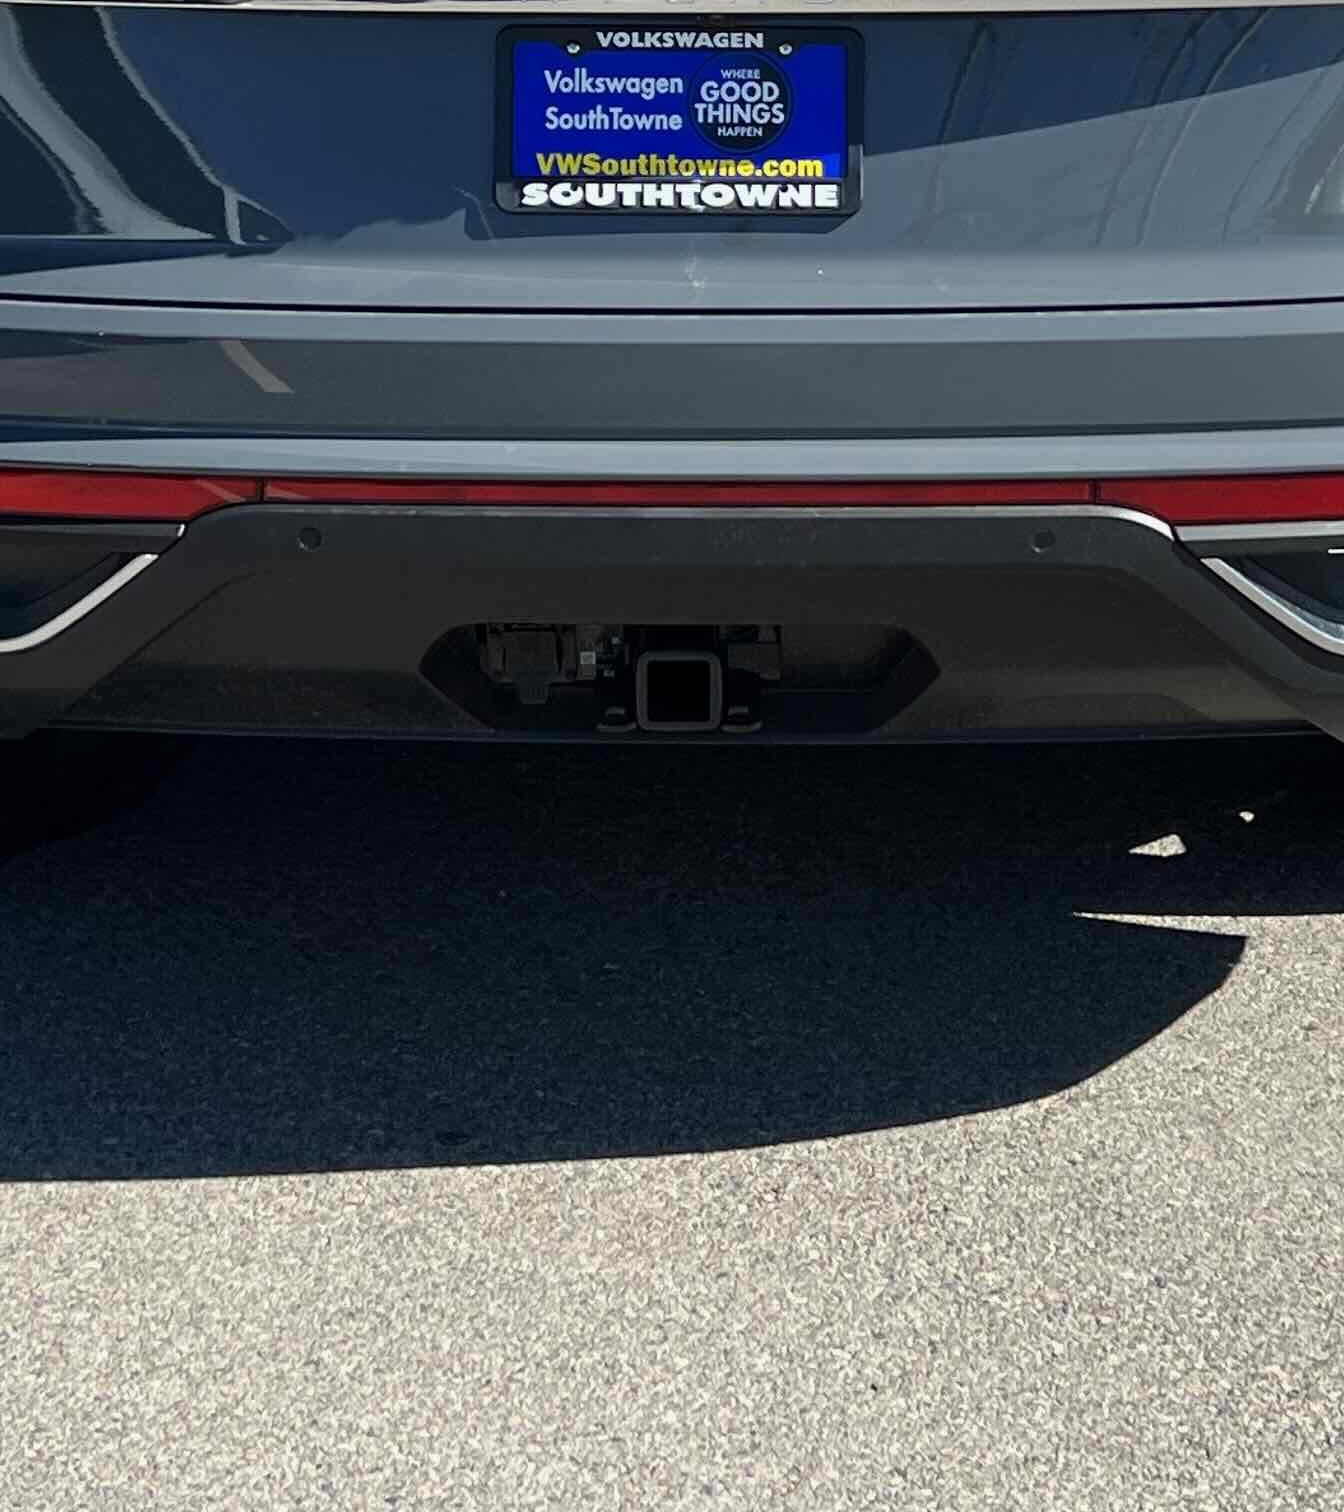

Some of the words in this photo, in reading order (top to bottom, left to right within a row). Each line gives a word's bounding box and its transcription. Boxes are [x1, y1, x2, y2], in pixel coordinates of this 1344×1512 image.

[596, 31, 764, 49] VOLKSWAGEN
[544, 67, 684, 100] Volkswagen
[720, 69, 760, 79] WHERE
[700, 81, 780, 102] GOOD
[695, 103, 785, 125] THINGS
[717, 126, 763, 138] HAPPEN
[536, 152, 823, 178] VWSouthtowne.com
[520, 182, 839, 209] SOUTHTOWNE
